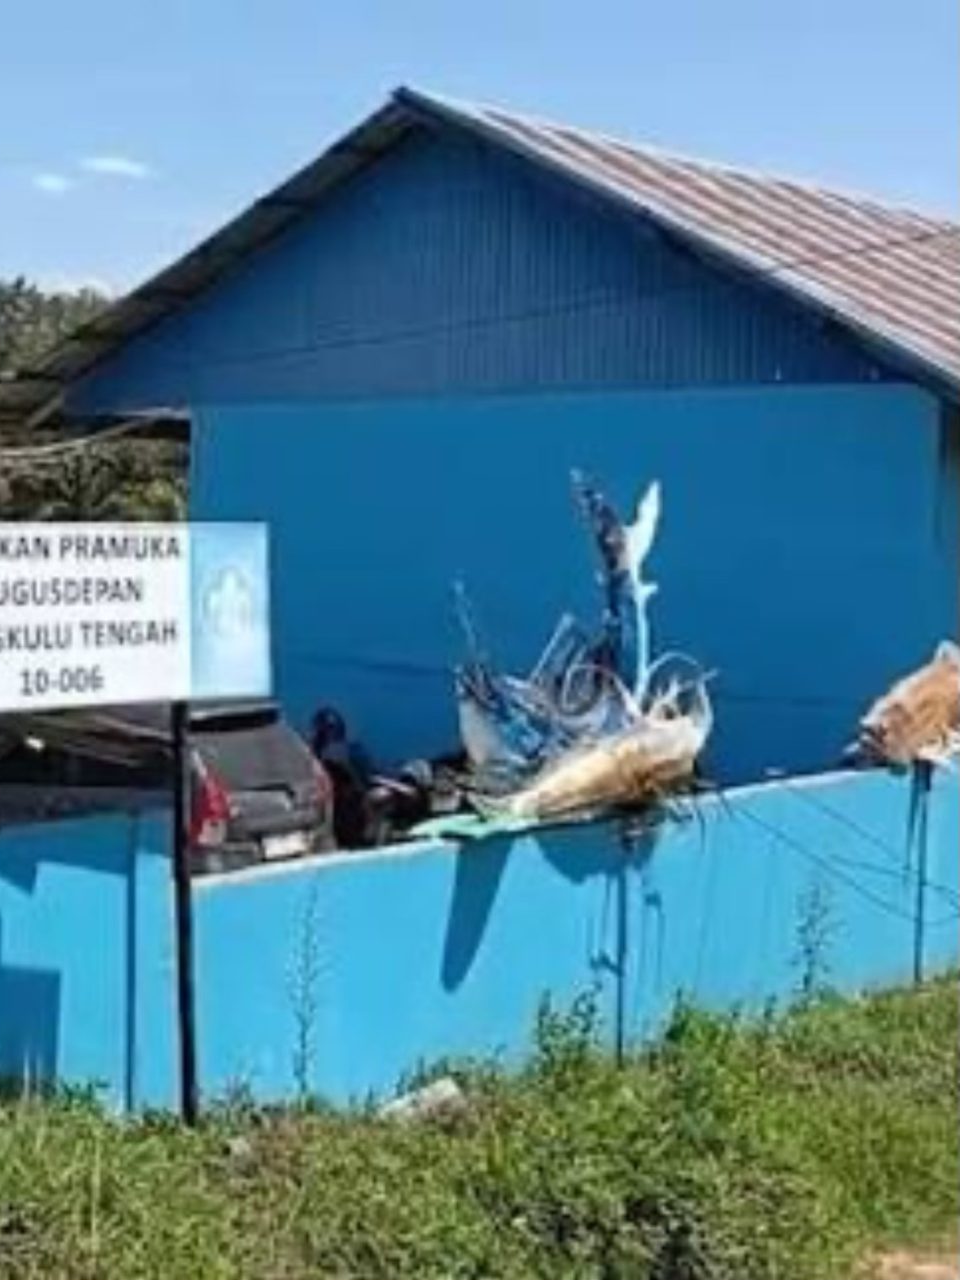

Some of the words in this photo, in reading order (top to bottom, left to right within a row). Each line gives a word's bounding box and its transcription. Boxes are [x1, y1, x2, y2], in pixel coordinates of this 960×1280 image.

[59, 534, 181, 560] PRAMUKA
[81, 621, 177, 647] TENGAH
[21, 667, 104, 695] 10-006
